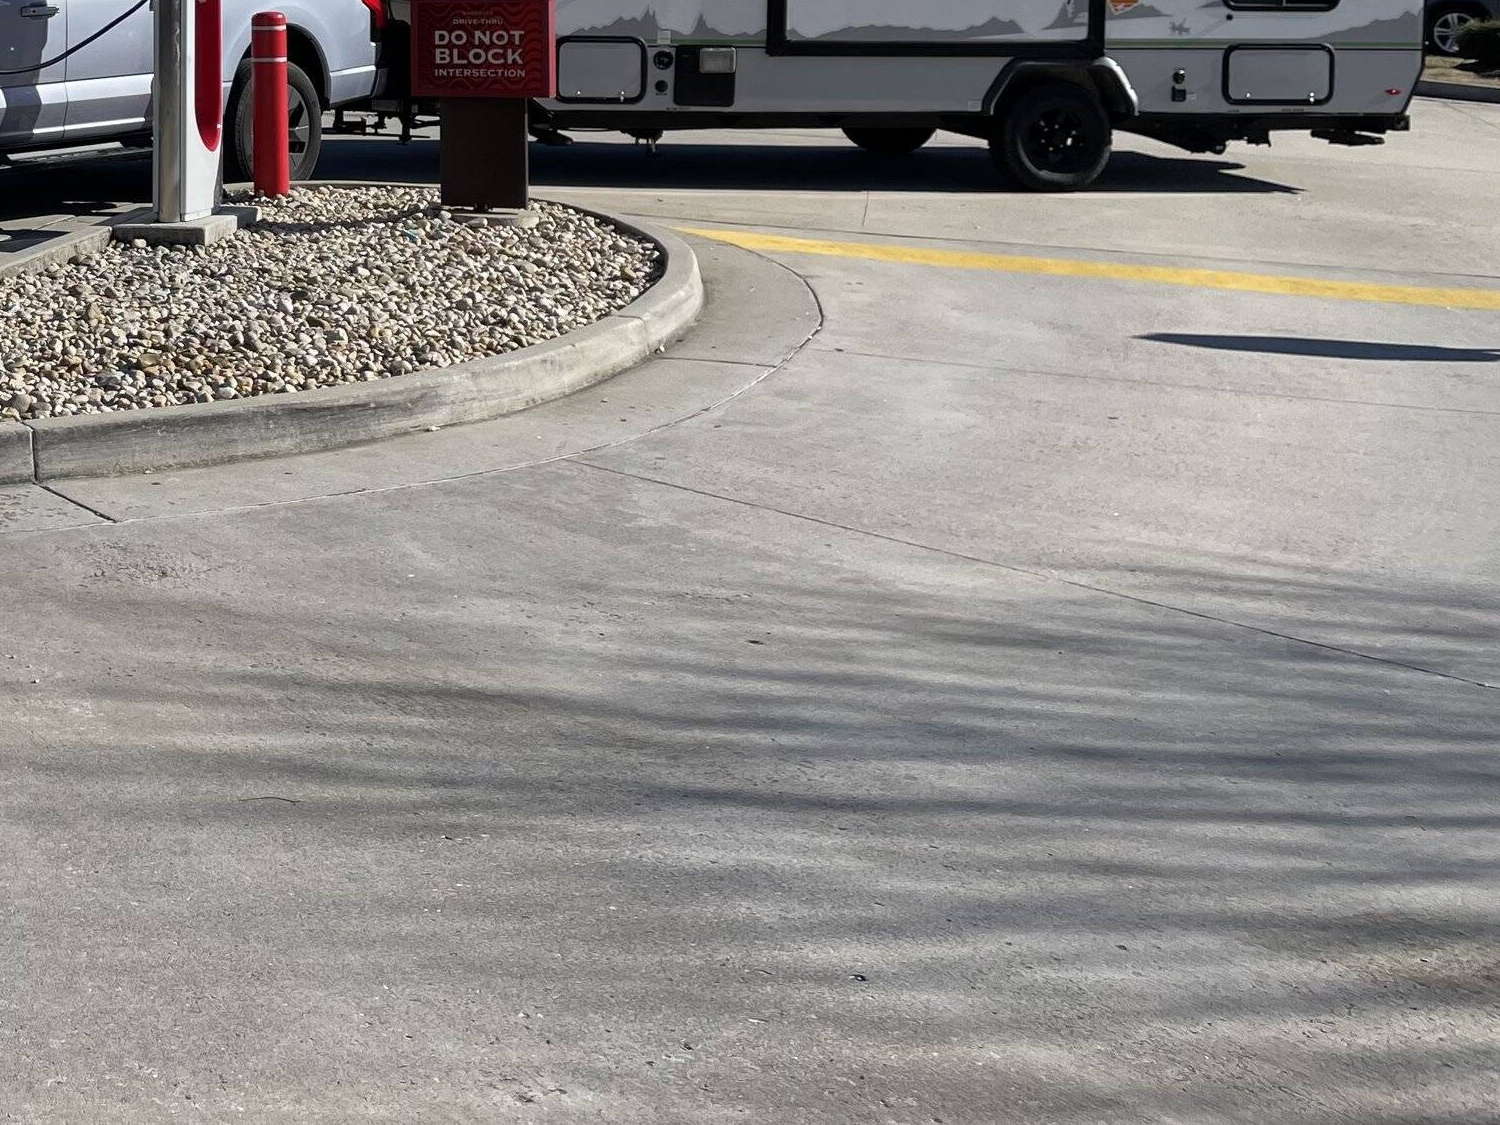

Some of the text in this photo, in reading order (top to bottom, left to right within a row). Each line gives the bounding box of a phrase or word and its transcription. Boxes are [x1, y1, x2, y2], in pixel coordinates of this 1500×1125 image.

[434, 30, 525, 45] DO NOT
[435, 48, 524, 64] BLOCK
[434, 68, 526, 77] INTERSECTION
